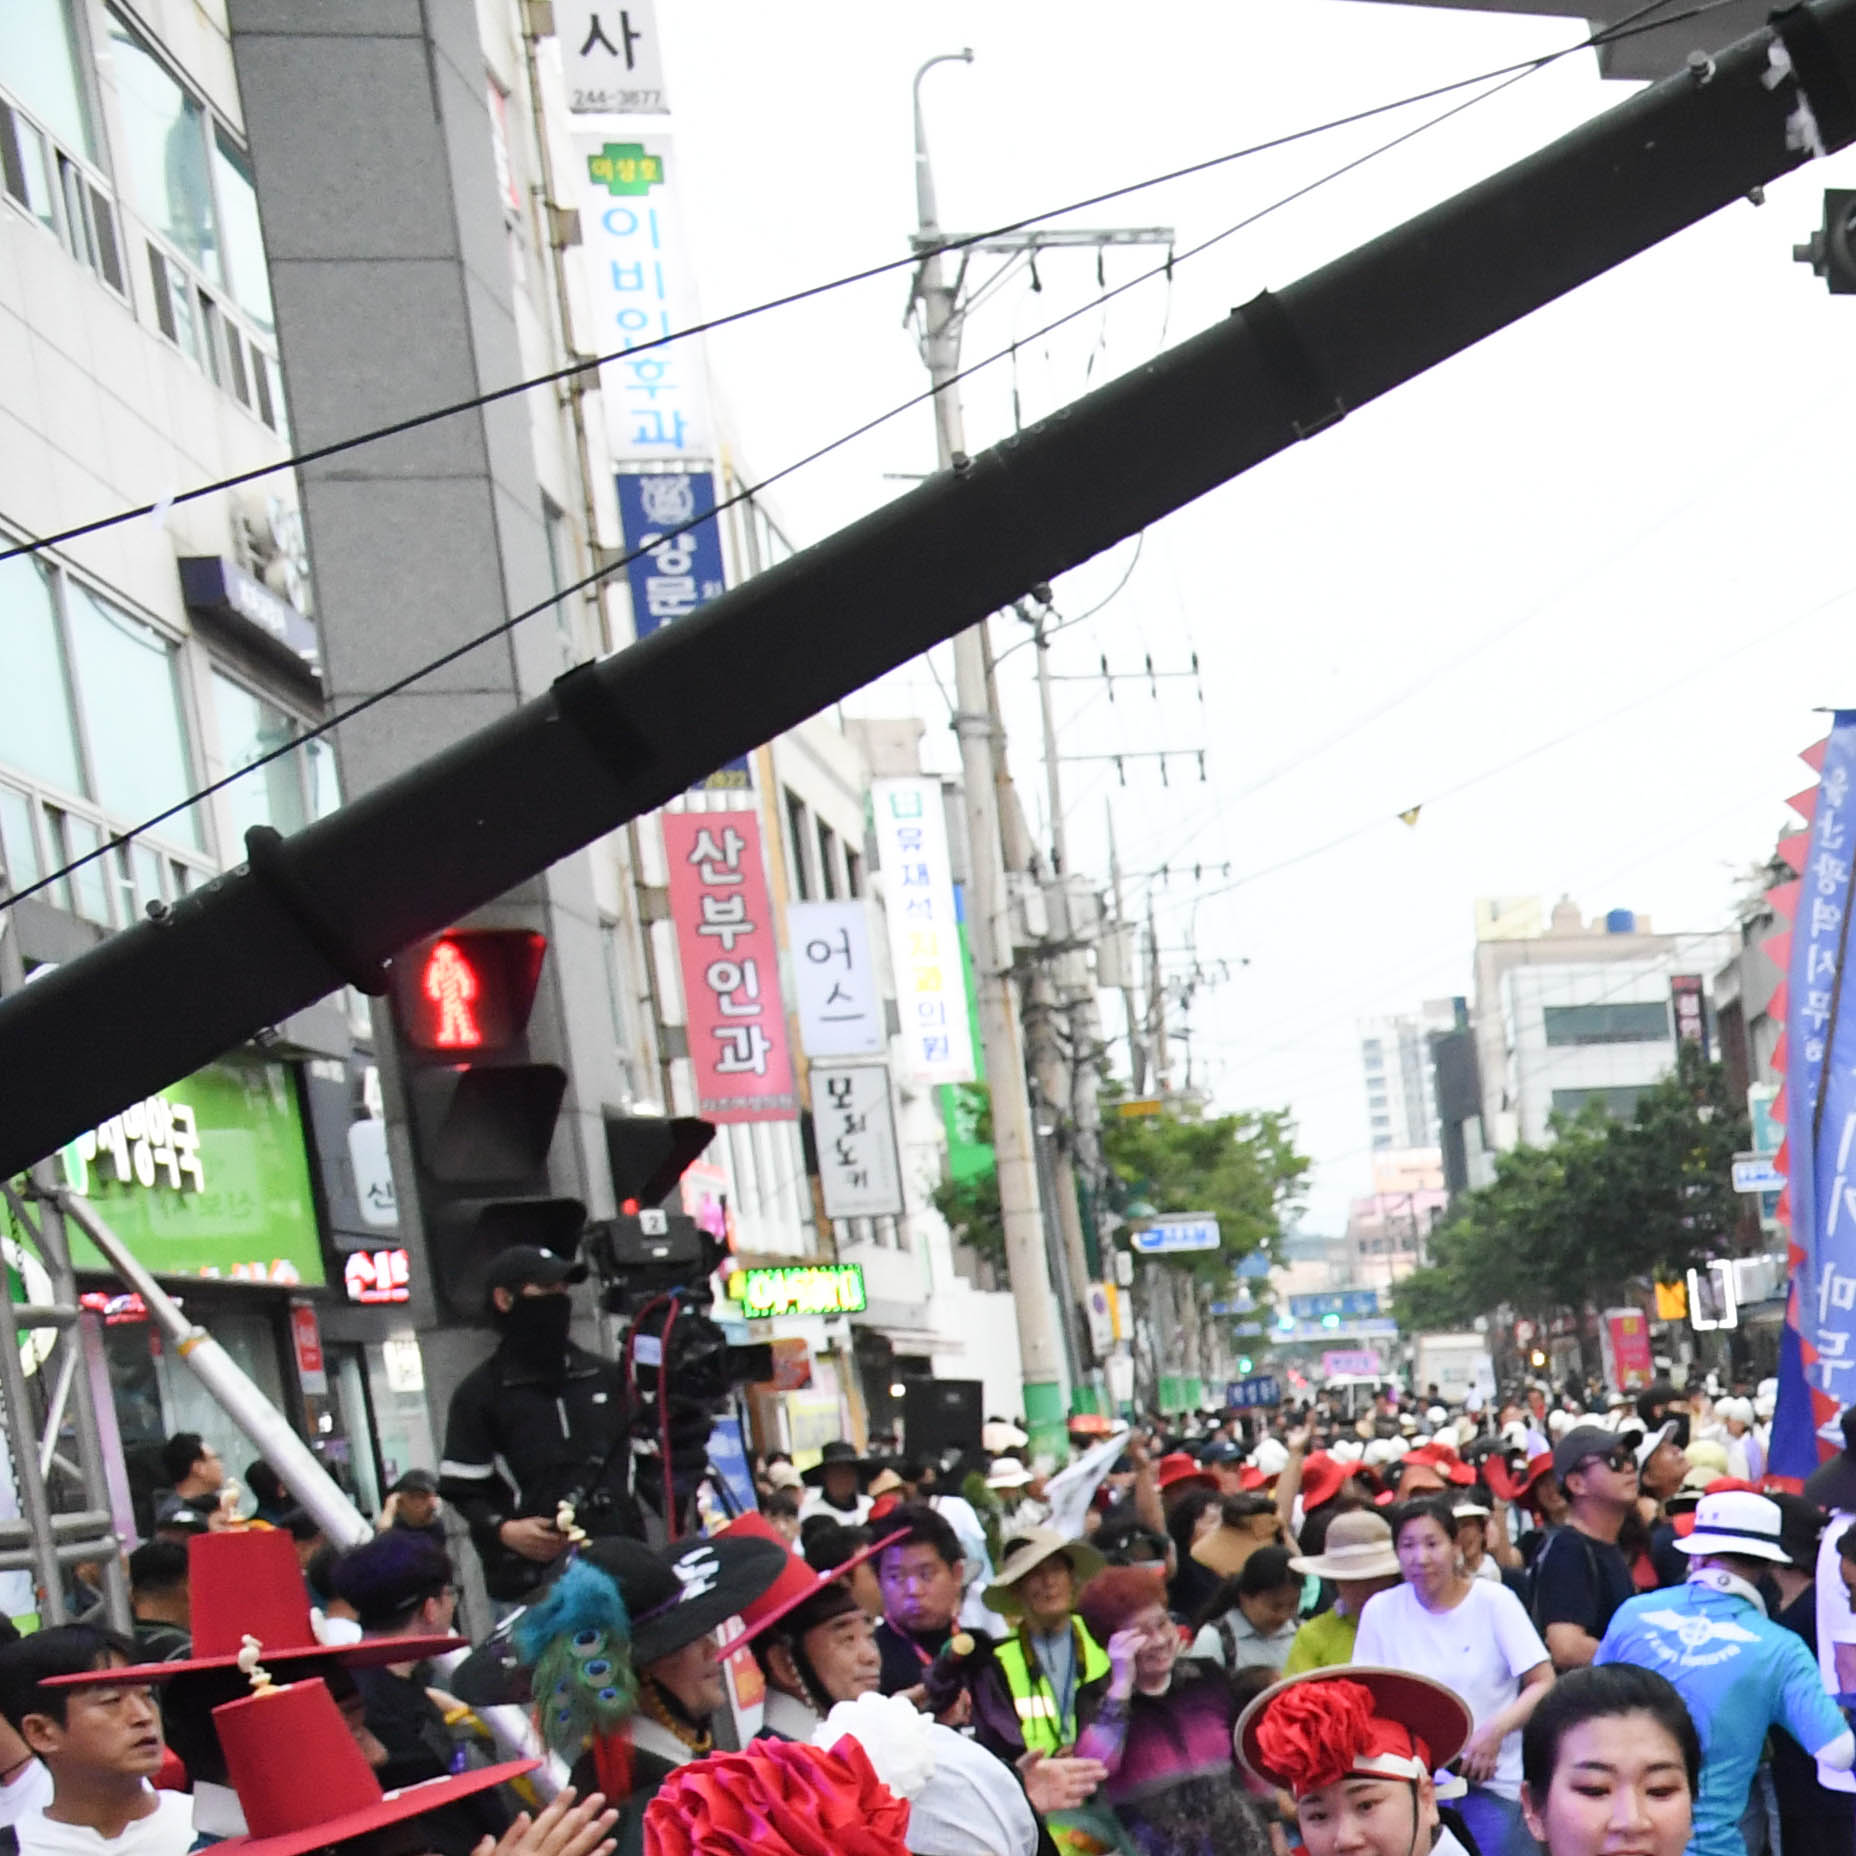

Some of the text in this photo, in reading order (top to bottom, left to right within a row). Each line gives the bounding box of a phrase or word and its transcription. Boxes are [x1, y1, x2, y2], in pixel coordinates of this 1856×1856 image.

[579, 10, 642, 71] 사
[601, 207, 688, 449] 이비인후과
[687, 827, 772, 1076] 산부인과
